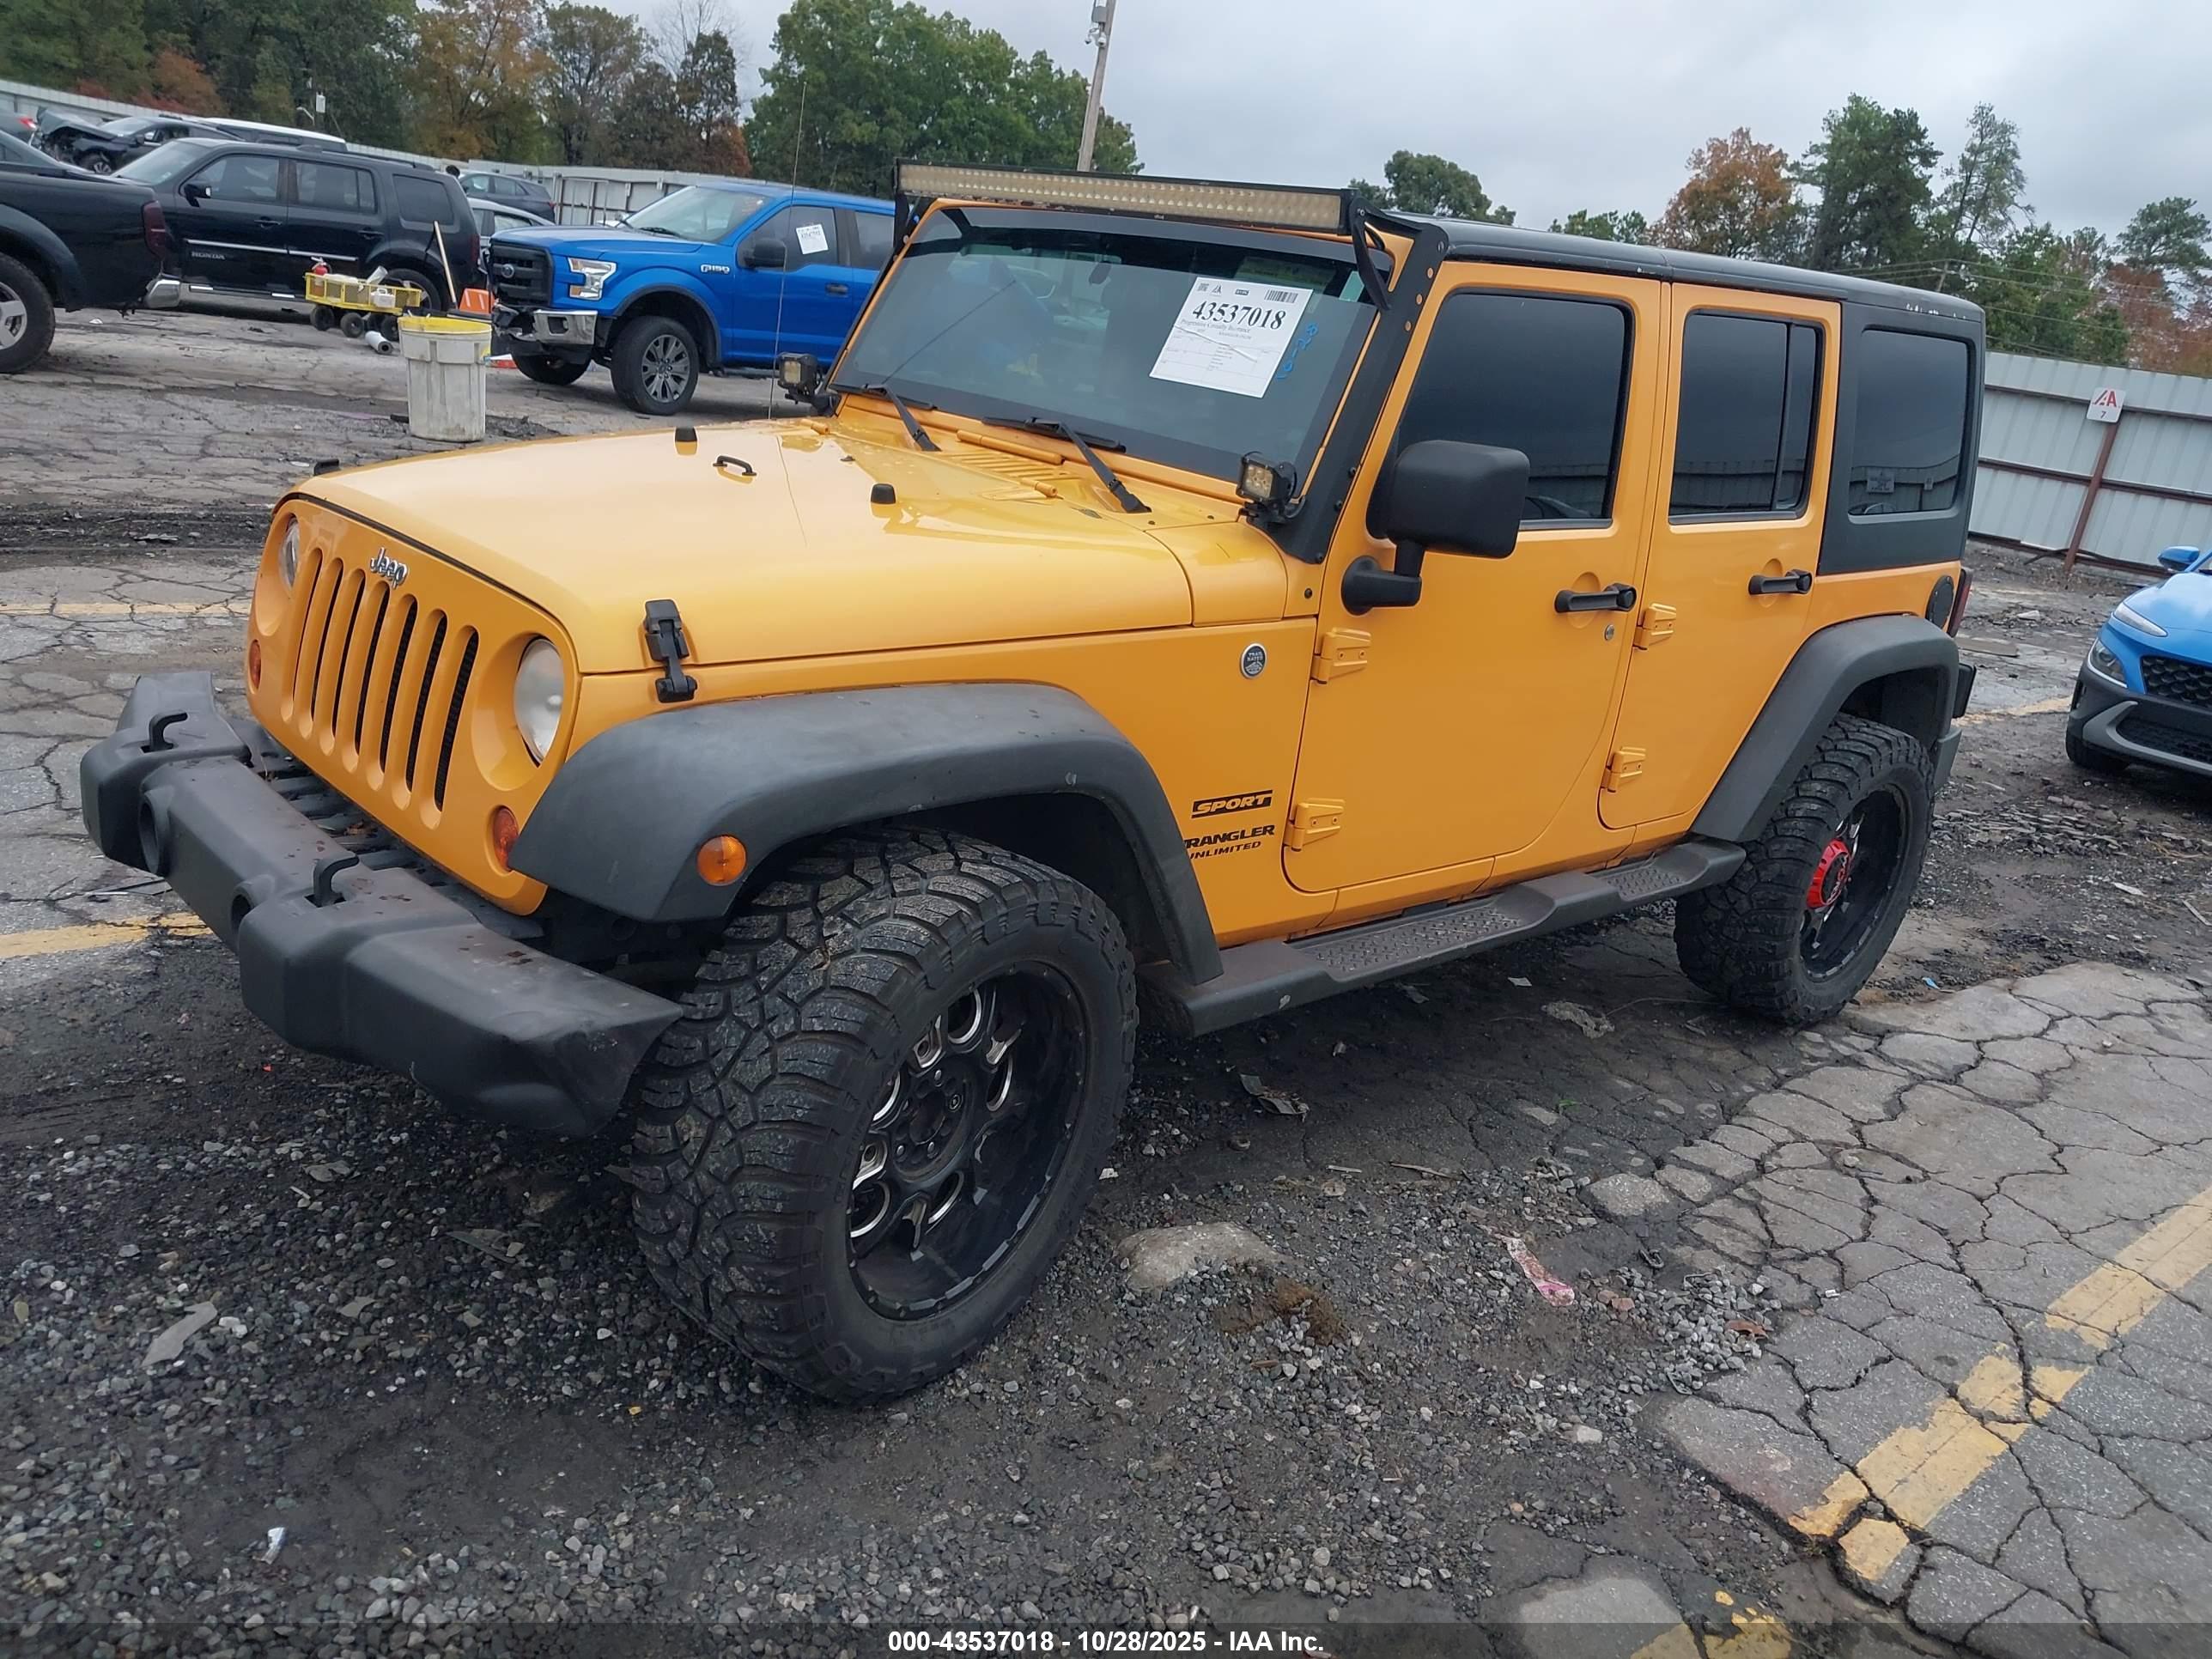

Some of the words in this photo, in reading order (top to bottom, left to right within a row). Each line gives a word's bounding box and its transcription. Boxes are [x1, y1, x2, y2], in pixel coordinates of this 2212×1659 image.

[191, 251, 225, 259] HONDA
[1192, 300, 1287, 331] 43537018
[2100, 410, 2106, 419] 7
[370, 546, 408, 590] Jeep
[1192, 793, 1273, 818] SPORT
[1184, 824, 1276, 848] RANGLER
